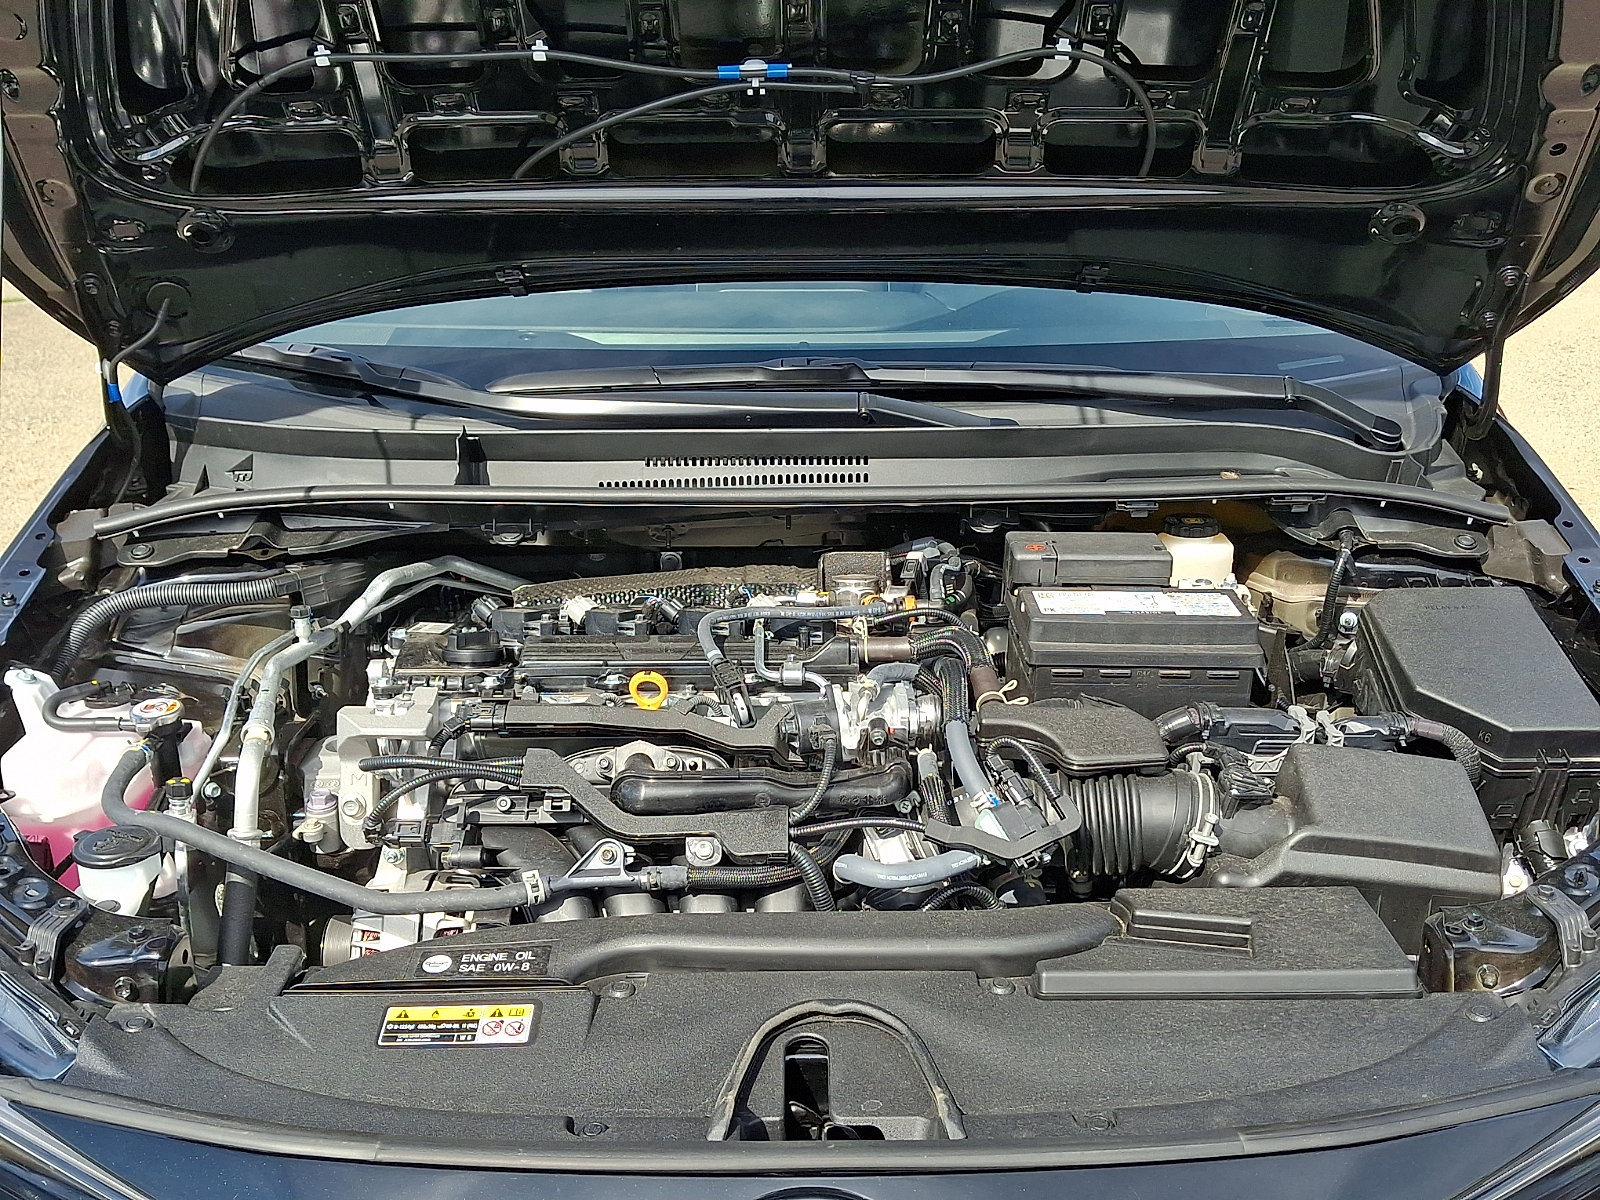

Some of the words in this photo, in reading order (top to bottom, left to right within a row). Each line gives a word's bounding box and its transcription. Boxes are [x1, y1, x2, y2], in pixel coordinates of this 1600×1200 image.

[1478, 730, 1491, 743] K6
[461, 952, 508, 963] ENGINE
[515, 951, 536, 961] OIL
[458, 963, 486, 973] SAE
[493, 962, 531, 972] 0W-8
